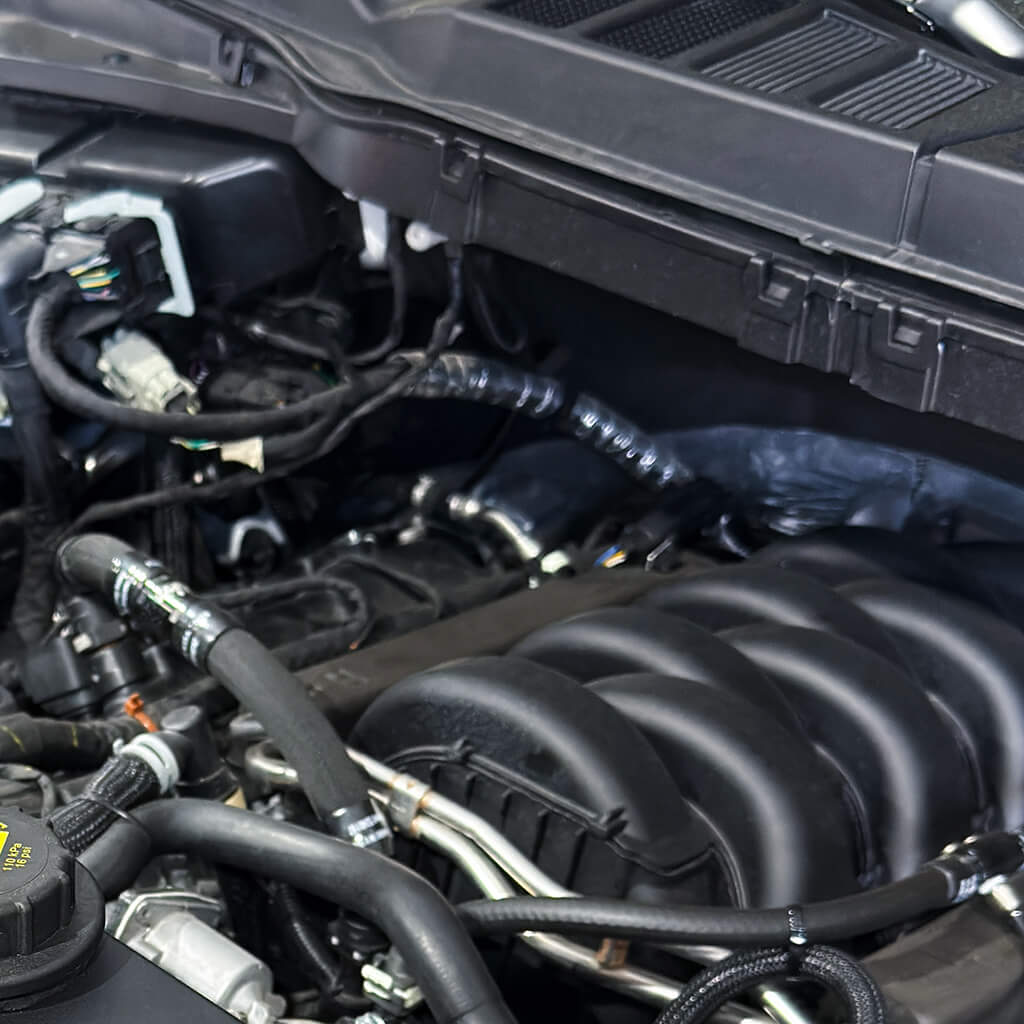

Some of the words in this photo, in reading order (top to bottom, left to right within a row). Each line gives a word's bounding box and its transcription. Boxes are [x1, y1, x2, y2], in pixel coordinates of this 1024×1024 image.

[7, 843, 23, 857] kPa
[15, 860, 27, 868] 16
[21, 846, 32, 859] psi
[2, 857, 16, 871] 110
